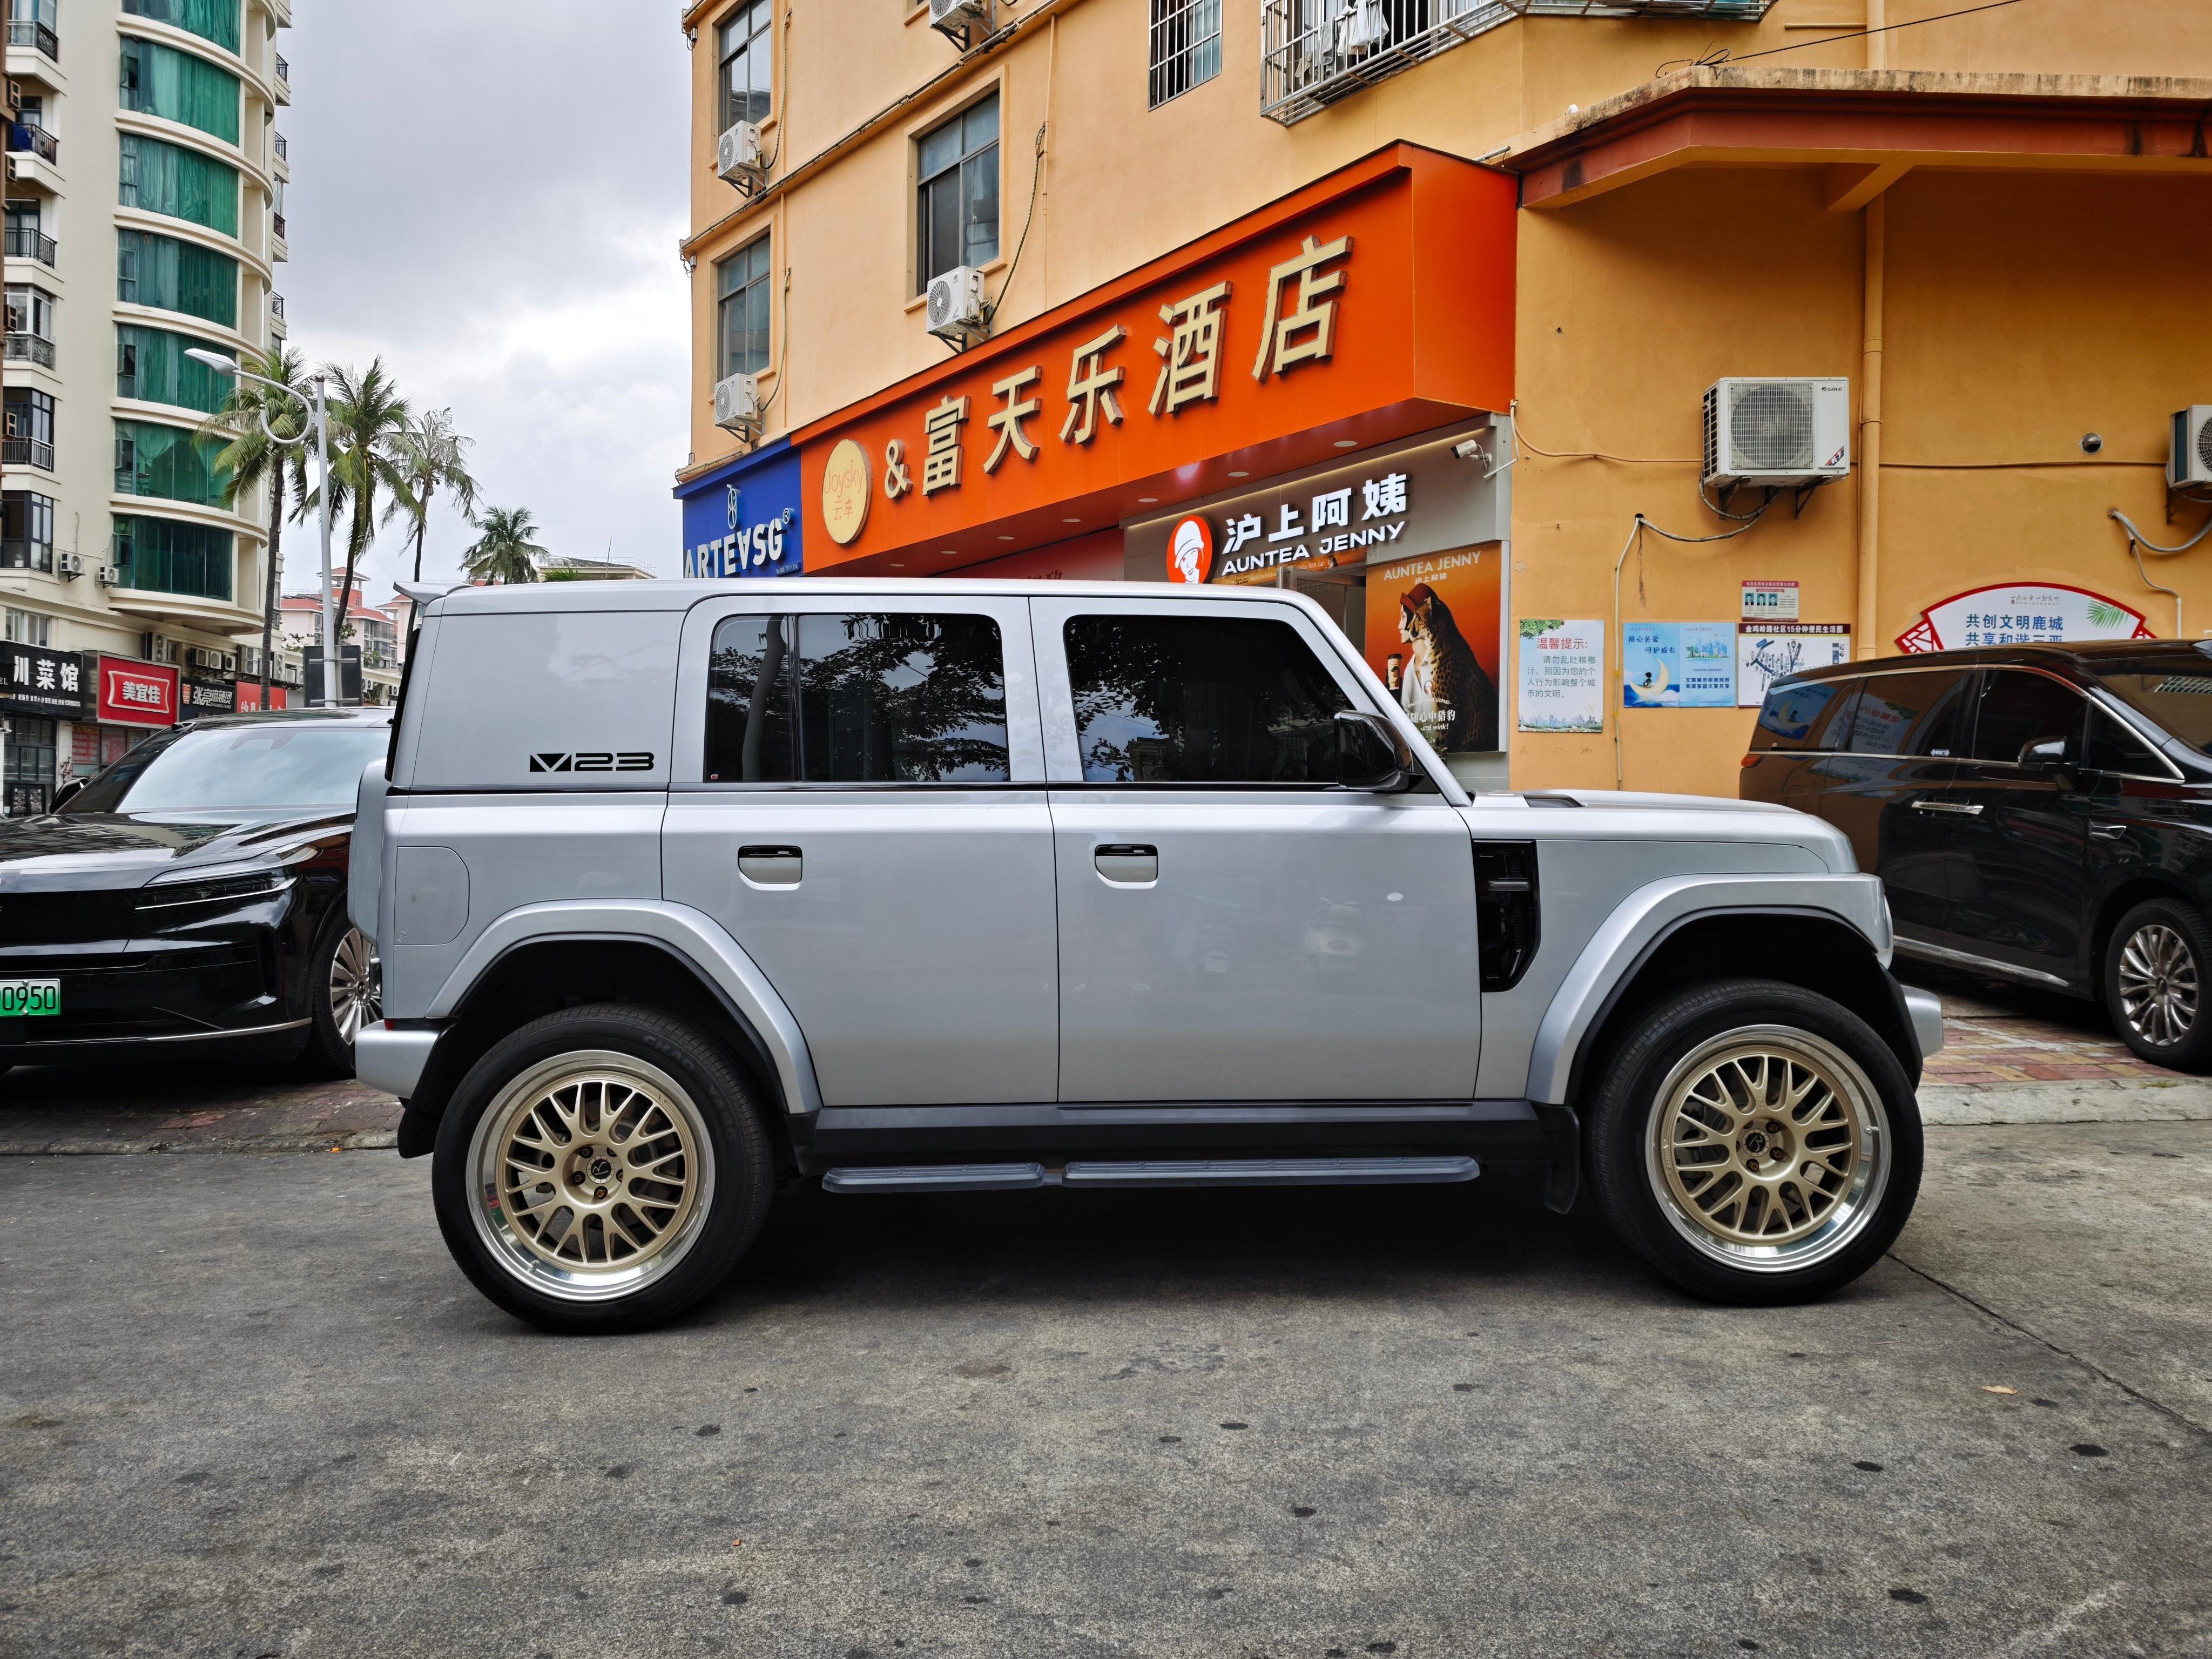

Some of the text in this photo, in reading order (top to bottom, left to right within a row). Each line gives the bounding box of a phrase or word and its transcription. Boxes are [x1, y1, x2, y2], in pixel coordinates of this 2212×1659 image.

[824, 459, 864, 498] Joysky
[833, 497, 854, 521] 云享
[1222, 473, 1407, 555] 沪上阿姨
[1221, 521, 1406, 576] AUNTEA JENNY
[1383, 550, 1482, 581] AUNTEA JENNY
[1965, 613, 2064, 631] 共创文明鹿城
[1542, 655, 1596, 665] 请勿乱吐槟榔
[14, 655, 79, 692] 川菜馆
[1527, 678, 1596, 687] 人行为影响整个城
[122, 681, 160, 704] 美宜佳
[192, 686, 233, 706] 张亮麻辣烫
[1406, 709, 1456, 724] 随心中猎豹
[0, 986, 56, 1011] 0950
[643, 1035, 695, 1071] CHAO
